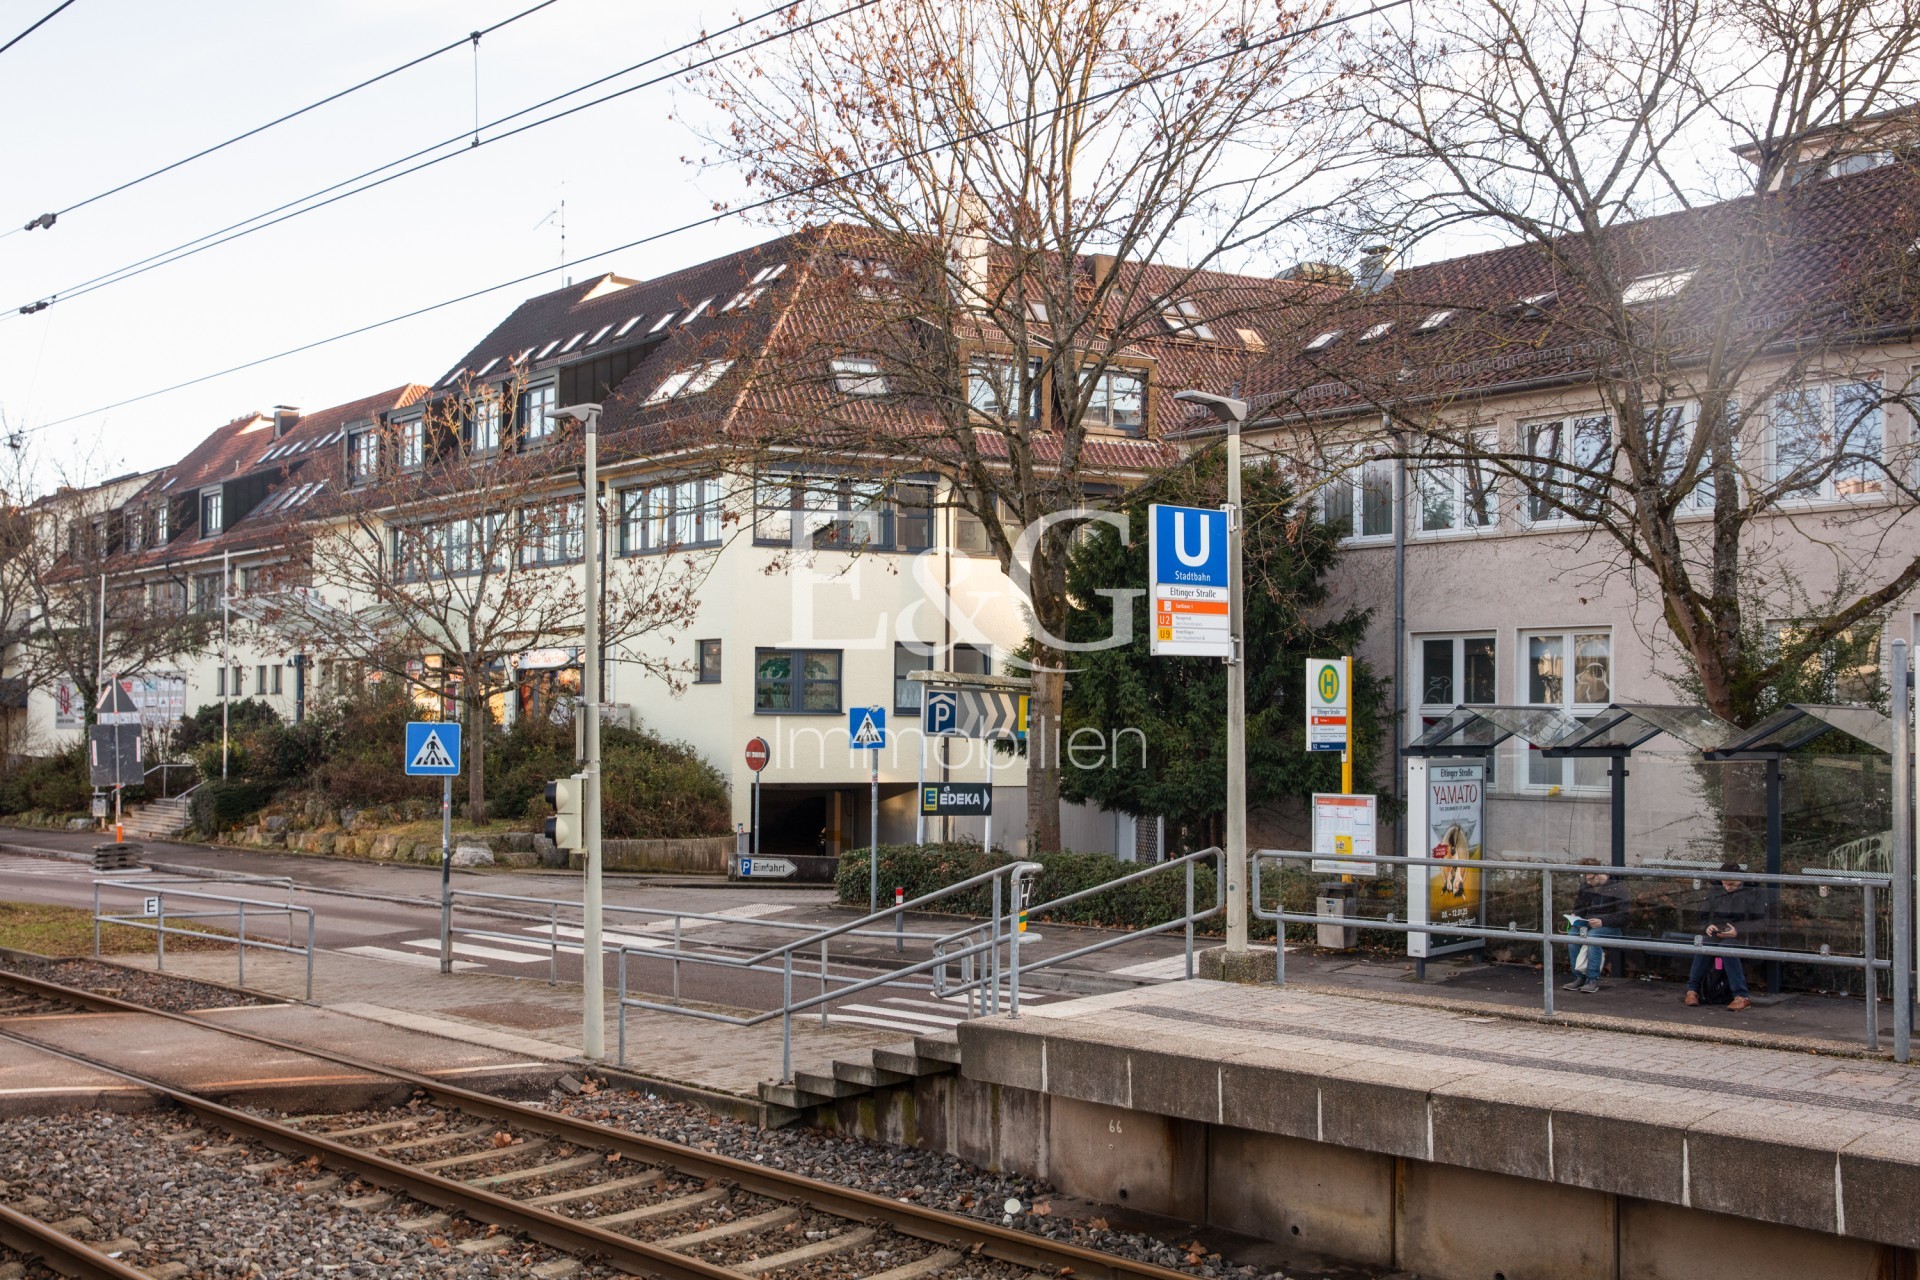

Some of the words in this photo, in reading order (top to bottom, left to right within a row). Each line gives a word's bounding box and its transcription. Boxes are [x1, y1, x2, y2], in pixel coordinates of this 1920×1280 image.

[1174, 512, 1210, 567] U
[1175, 570, 1211, 582] Stadtbahn
[1170, 587, 1194, 598] Eltinger
[1196, 589, 1216, 598] Straße
[1324, 674, 1334, 694] H
[935, 703, 950, 731] P
[1441, 769, 1458, 779] Eltinger
[1459, 768, 1473, 776] Straße
[940, 793, 980, 805] EDEKA
[1433, 784, 1477, 804] YAMATO
[742, 862, 750, 872] P
[753, 863, 785, 872] Einfahrt
[147, 899, 156, 913] E
[1109, 1120, 1122, 1133] 66
